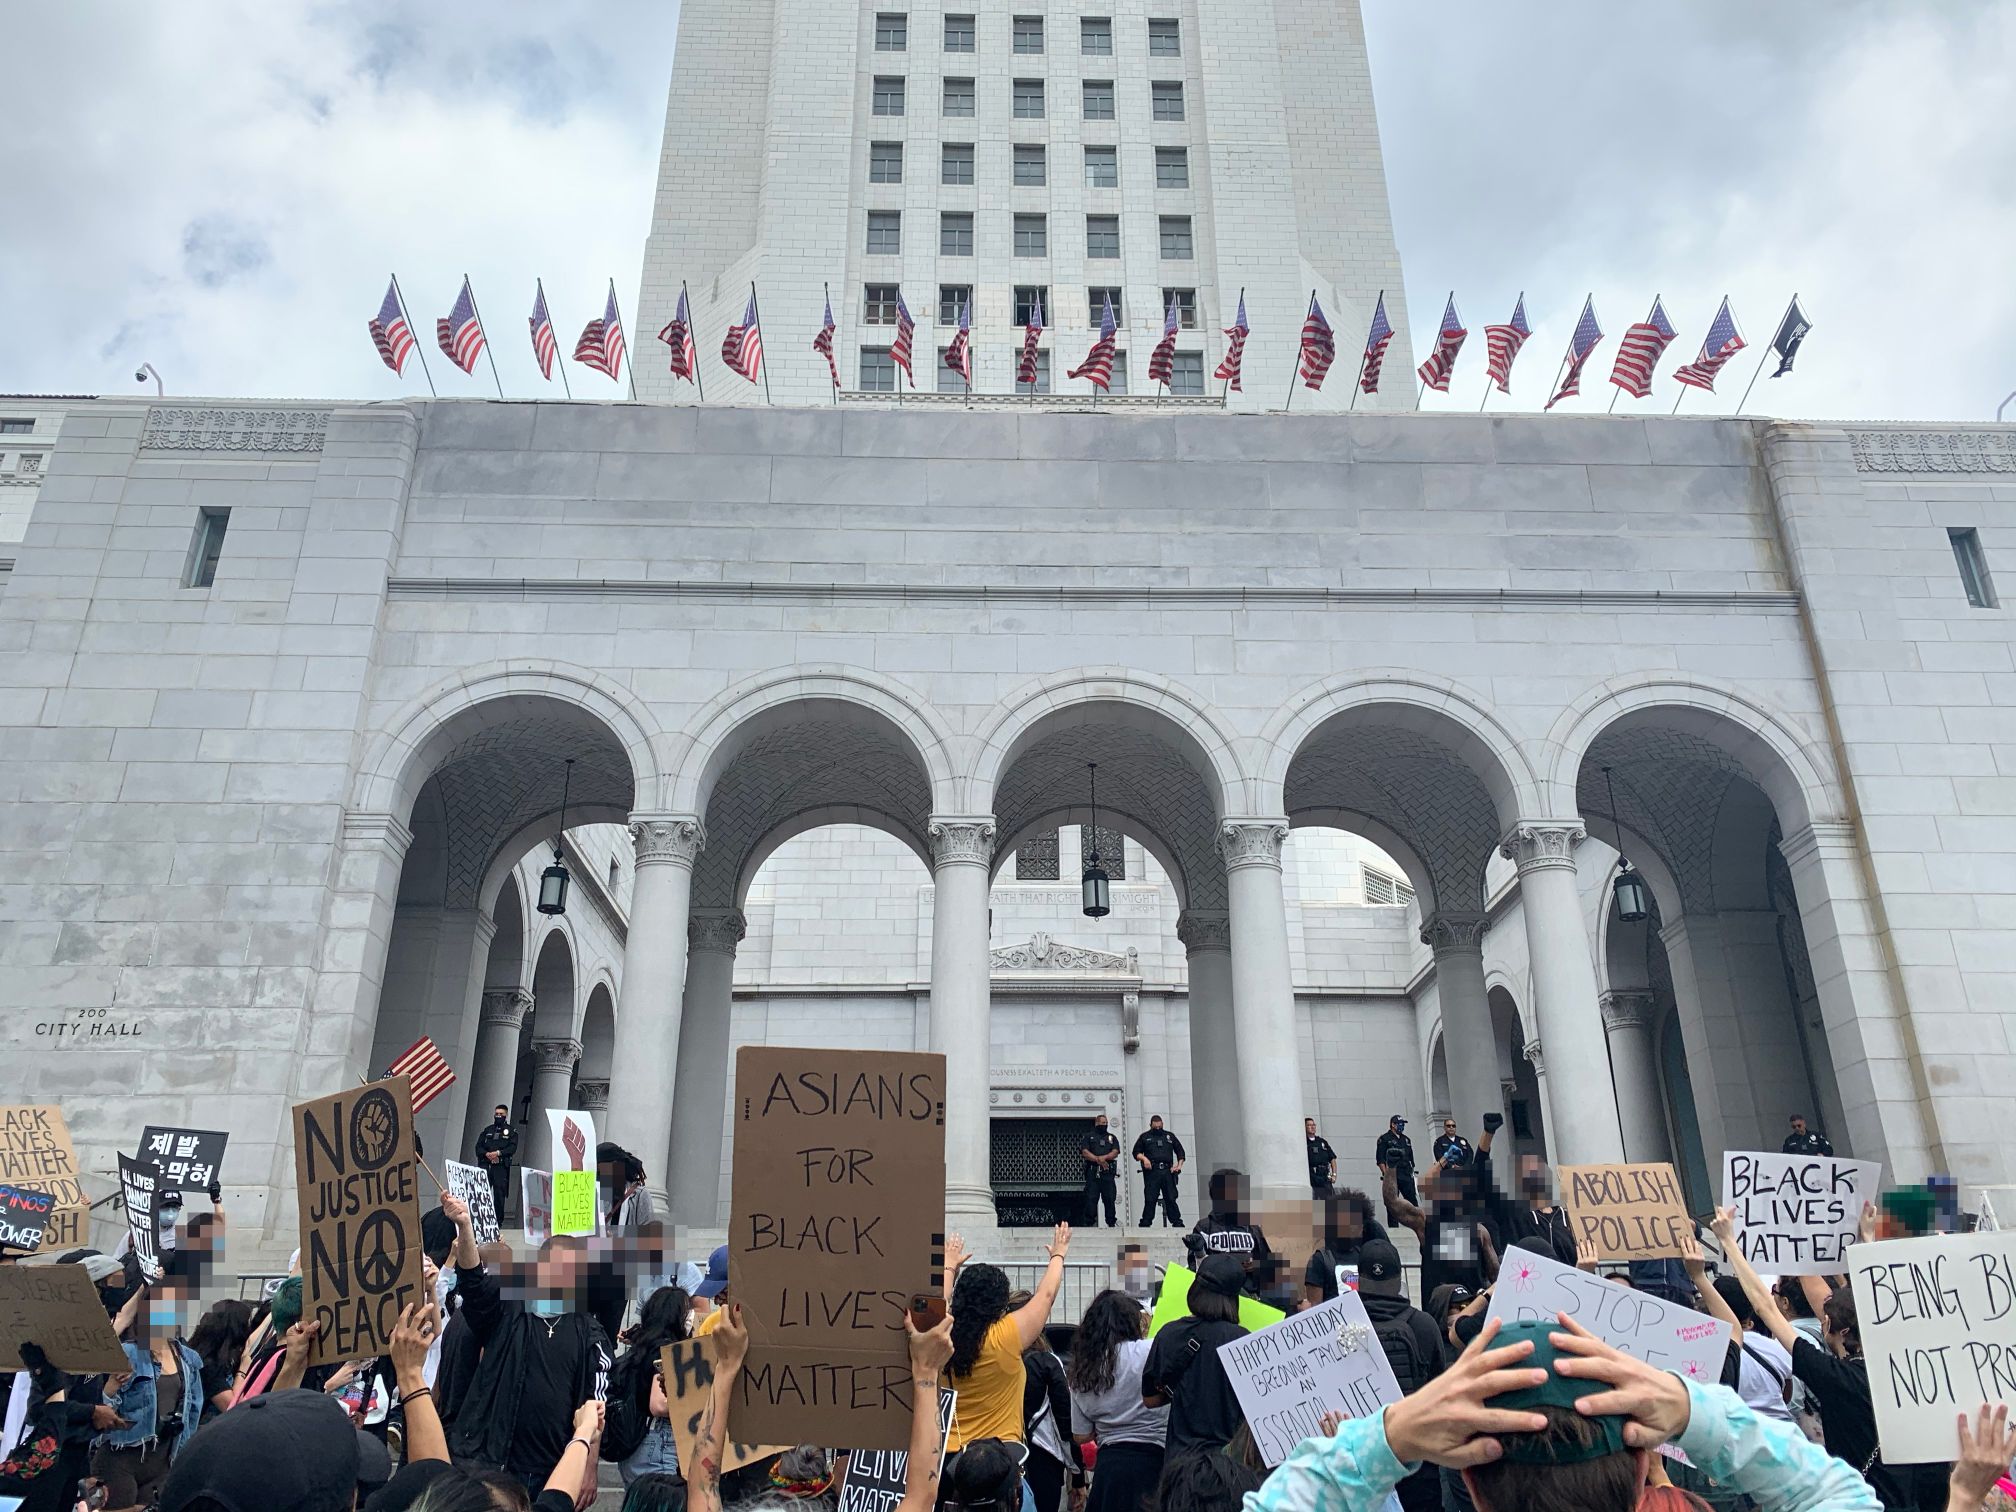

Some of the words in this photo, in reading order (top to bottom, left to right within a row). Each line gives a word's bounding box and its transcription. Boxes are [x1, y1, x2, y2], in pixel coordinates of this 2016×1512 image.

[1019, 893, 1044, 904] THAT
[1047, 893, 1078, 904] RIGHT
[1122, 893, 1155, 904] MIGHT
[35, 1023, 81, 1036] CITY
[90, 1023, 142, 1036] HALL
[78, 1008, 107, 1018] 200
[762, 1072, 932, 1121] ASIANS
[0, 1109, 51, 1131] ACK
[133, 1172, 155, 1192] LIVES
[559, 1173, 591, 1193] BLACK
[796, 1148, 874, 1187] FOR
[1731, 1155, 1858, 1198] BLACK
[125, 1184, 152, 1210] CANNOT
[311, 1161, 413, 1223] JUSTICE
[562, 1193, 590, 1211] LIVES
[1572, 1170, 1680, 1209] ABOLISH
[128, 1207, 152, 1230] MATTER
[557, 1211, 592, 1230] MATTER
[1744, 1199, 1845, 1227] LIVES
[744, 1213, 885, 1257] BLACK
[1210, 1231, 1254, 1251] PUMA
[1580, 1215, 1684, 1252] POLICE
[1722, 1232, 1857, 1264] MATTER
[779, 1287, 907, 1331] LIVES
[1542, 1272, 1665, 1338] STOP
[1859, 1255, 1971, 1332] BEING
[1228, 1332, 1281, 1377] HAPPY
[1280, 1303, 1348, 1351] BIRTHDAY
[743, 1363, 914, 1413] MATTER
[1251, 1355, 1312, 1397] BREONNA
[1299, 1376, 1317, 1394] AN
[1889, 1346, 1957, 1409] NOT
